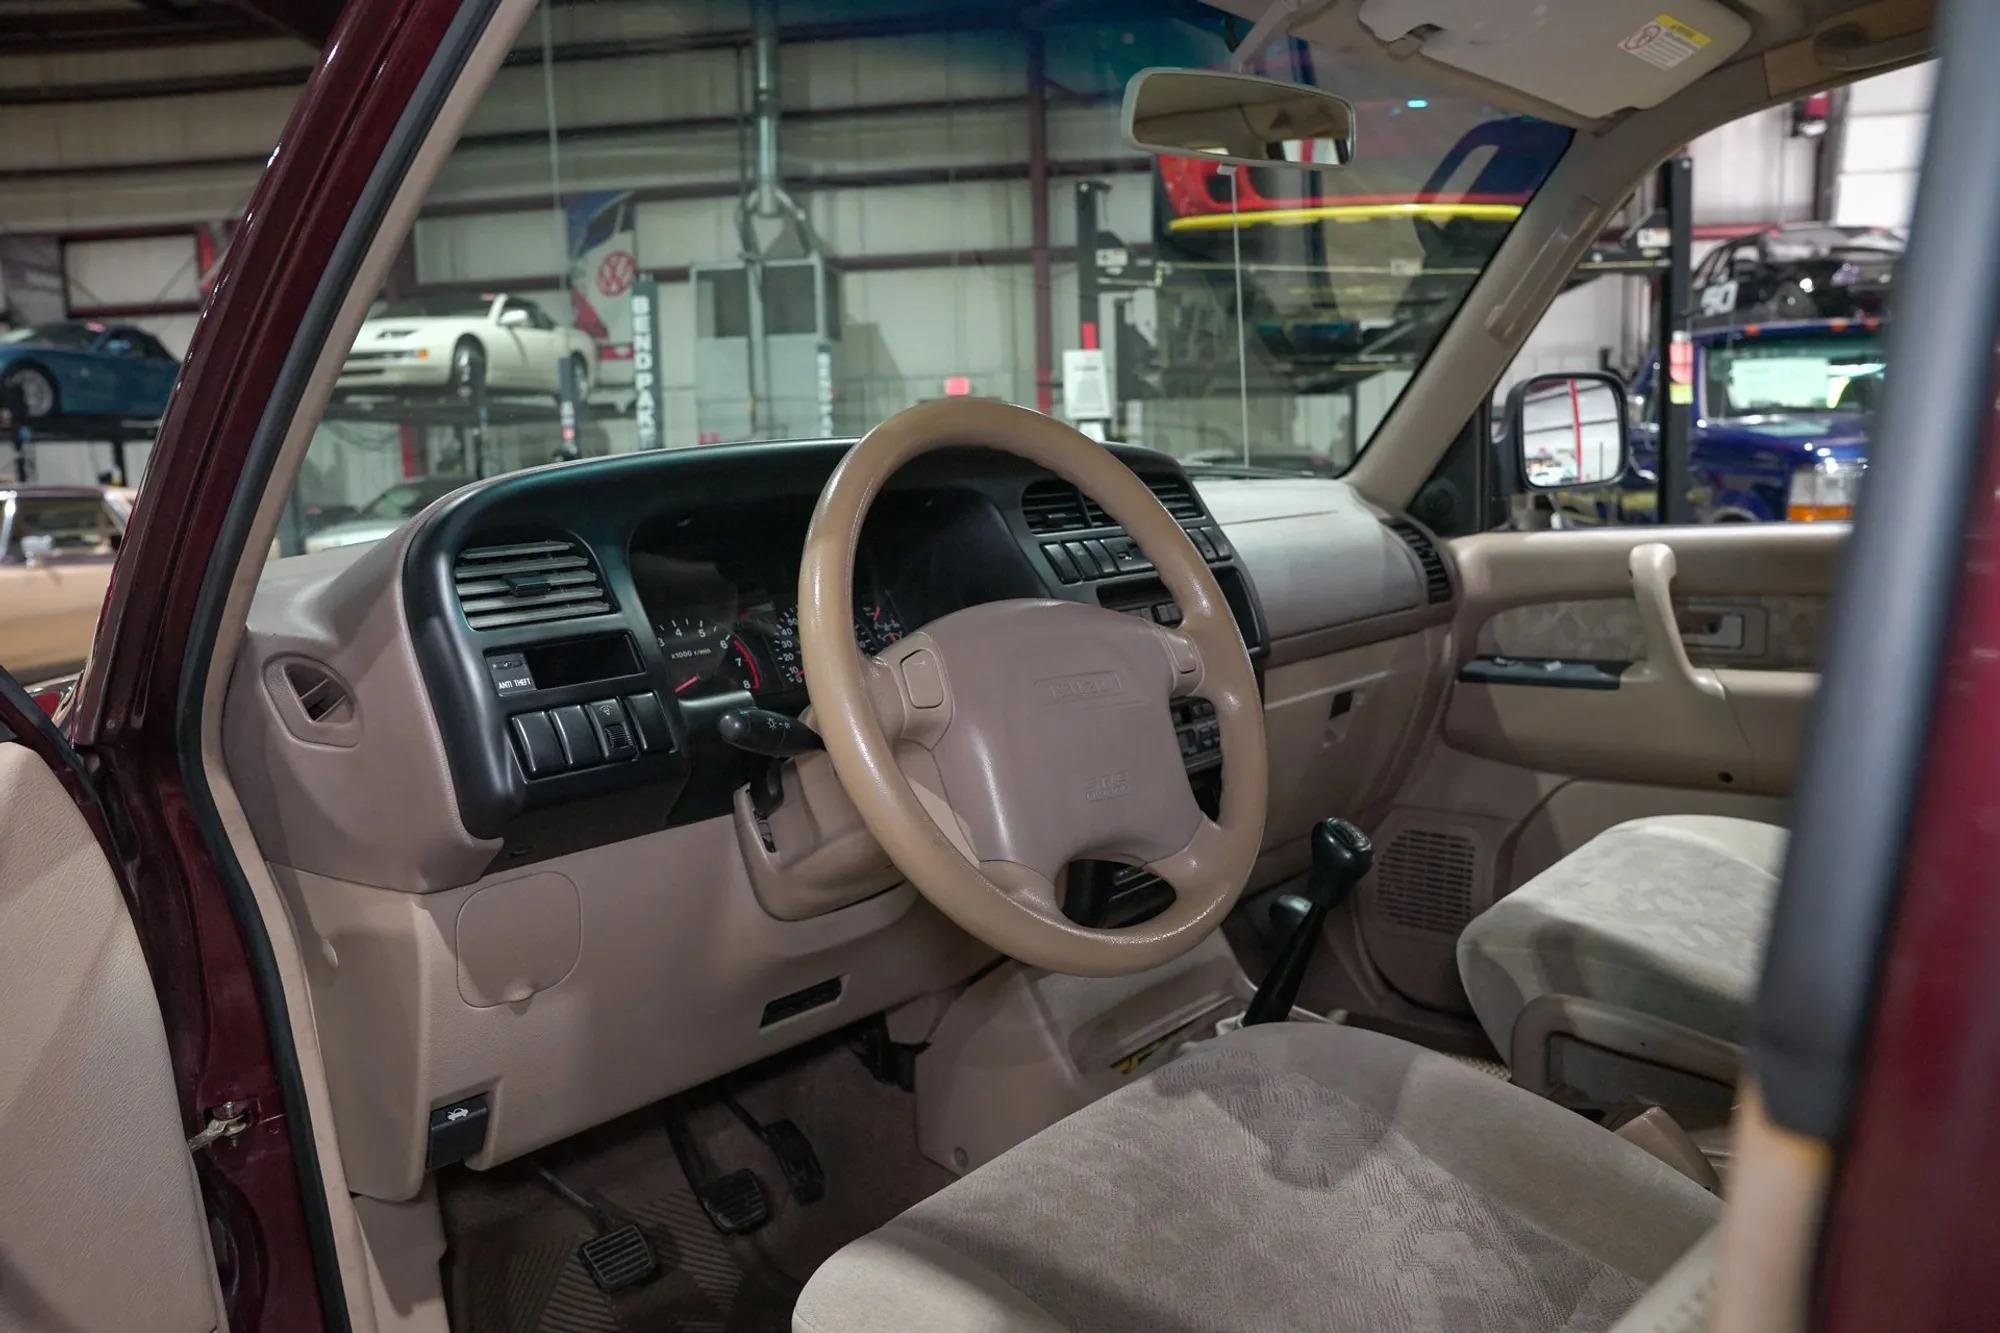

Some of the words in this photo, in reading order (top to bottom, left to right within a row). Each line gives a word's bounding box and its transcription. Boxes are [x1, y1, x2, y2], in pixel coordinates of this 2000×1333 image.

[676, 628, 682, 636] 4
[698, 629, 706, 637] 5
[781, 628, 793, 636] 40
[720, 640, 728, 649] 6
[781, 639, 793, 648] 30
[783, 652, 794, 661] 20
[735, 658, 741, 666] 7
[788, 665, 799, 675] 10
[498, 680, 513, 690] ANTI
[513, 677, 531, 687] THEFT
[743, 680, 751, 689] 8
